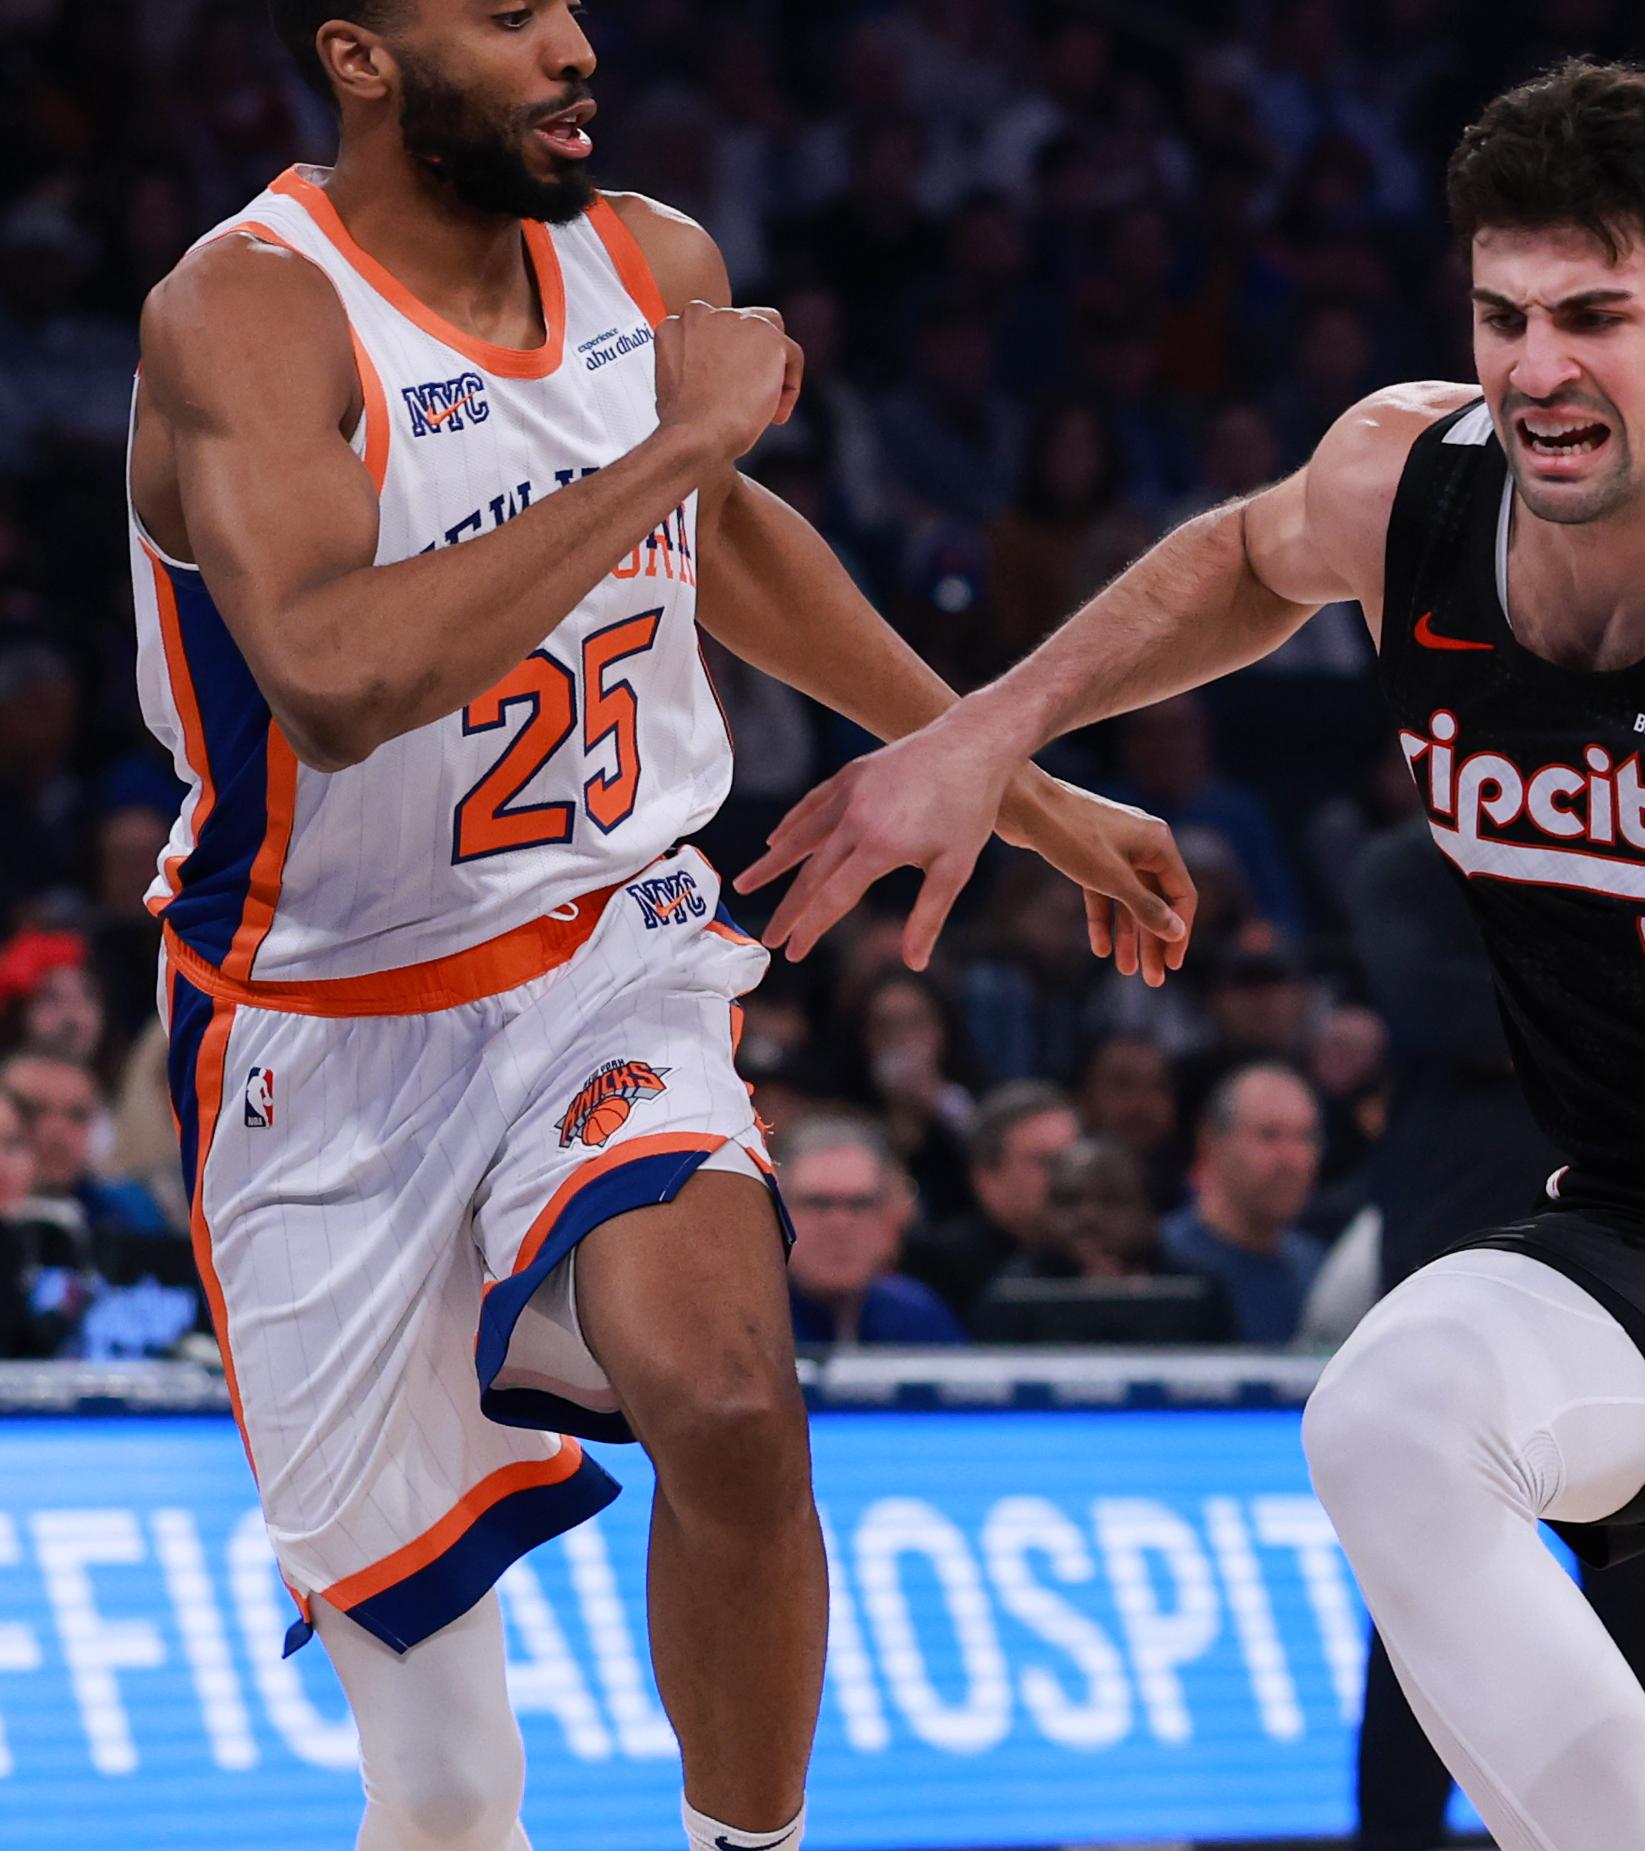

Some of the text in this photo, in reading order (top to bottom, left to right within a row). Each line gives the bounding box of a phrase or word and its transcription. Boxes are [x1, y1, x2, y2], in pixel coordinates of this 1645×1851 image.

[578, 327, 619, 353] experience
[586, 322, 655, 371] abu dhabi
[401, 372, 489, 438] NYC
[451, 606, 665, 866] 25
[625, 870, 707, 930] NYC
[559, 1060, 667, 1148] KNICKS
